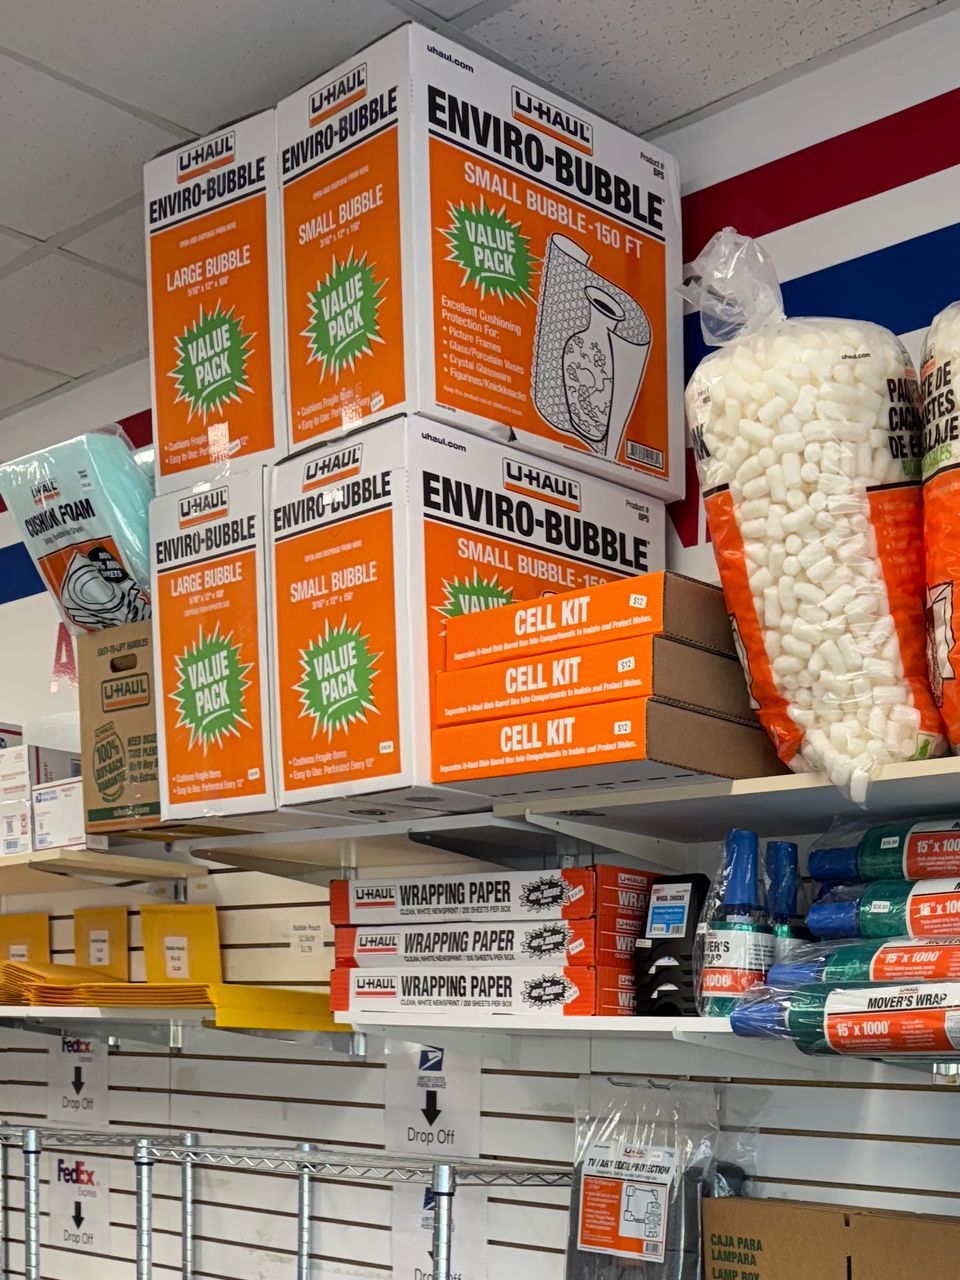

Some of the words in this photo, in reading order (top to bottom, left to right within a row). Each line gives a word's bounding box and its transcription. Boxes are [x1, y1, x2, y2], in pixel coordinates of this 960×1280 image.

[427, 44, 474, 73] uhaul.com
[311, 71, 365, 113] U-HAUL
[282, 85, 398, 176] ENVIRO-BUBBLE
[515, 91, 590, 143] U-HAUL
[428, 84, 663, 231] ENVIRO-BUBBLE
[150, 156, 265, 224] ENVIRO-BUBBLE
[298, 208, 336, 245] SMALL
[339, 184, 383, 224] BUBBLE
[465, 220, 516, 253] VALUE
[166, 262, 202, 292] LARGE
[206, 245, 251, 278] BUBBLE
[474, 248, 516, 276] PACK
[321, 272, 364, 321] VALUE
[328, 302, 364, 346] PACK
[441, 295, 478, 317] Excellent
[479, 309, 522, 336] Cushioning
[188, 324, 231, 365] VALUE
[449, 326, 474, 345] Picture
[475, 335, 502, 353] Frames
[195, 353, 232, 389] PACK
[421, 432, 466, 452] uhaul.com
[423, 471, 649, 572] ENVIRO-BUBBLE
[171, 572, 202, 597] LARGE
[205, 562, 243, 589] BUBBLE
[290, 575, 329, 603] SMALL
[332, 561, 377, 592] BUBBLE
[515, 604, 556, 635] CELL
[561, 596, 590, 626] KIT
[188, 650, 230, 690] VALUE
[505, 662, 547, 694] CELL
[553, 656, 581, 686] KIT
[195, 680, 230, 717] PACK
[501, 723, 541, 752] CELL
[547, 717, 575, 746] KIT
[916, 838, 933, 853] 15"
[933, 842, 941, 851] x
[400, 882, 465, 906] WRAPPING
[469, 880, 511, 903] PAPER
[404, 932, 469, 953] WRAPPING
[472, 929, 515, 951] PAPER
[401, 975, 466, 997] WRAPPING
[471, 975, 513, 998] PAPER
[867, 995, 914, 1009] MOVER'S
[916, 993, 948, 1007] WRAP
[62, 1037, 92, 1054] FedEx
[62, 1096, 80, 1110] Drop
[81, 1097, 94, 1110] Off
[407, 1127, 434, 1146] Drop
[437, 1129, 455, 1144] Off
[57, 1158, 95, 1186] FedEx
[710, 1233, 735, 1249] CAJA
[737, 1237, 763, 1252] PARA
[711, 1248, 757, 1266] LÁMPARA
